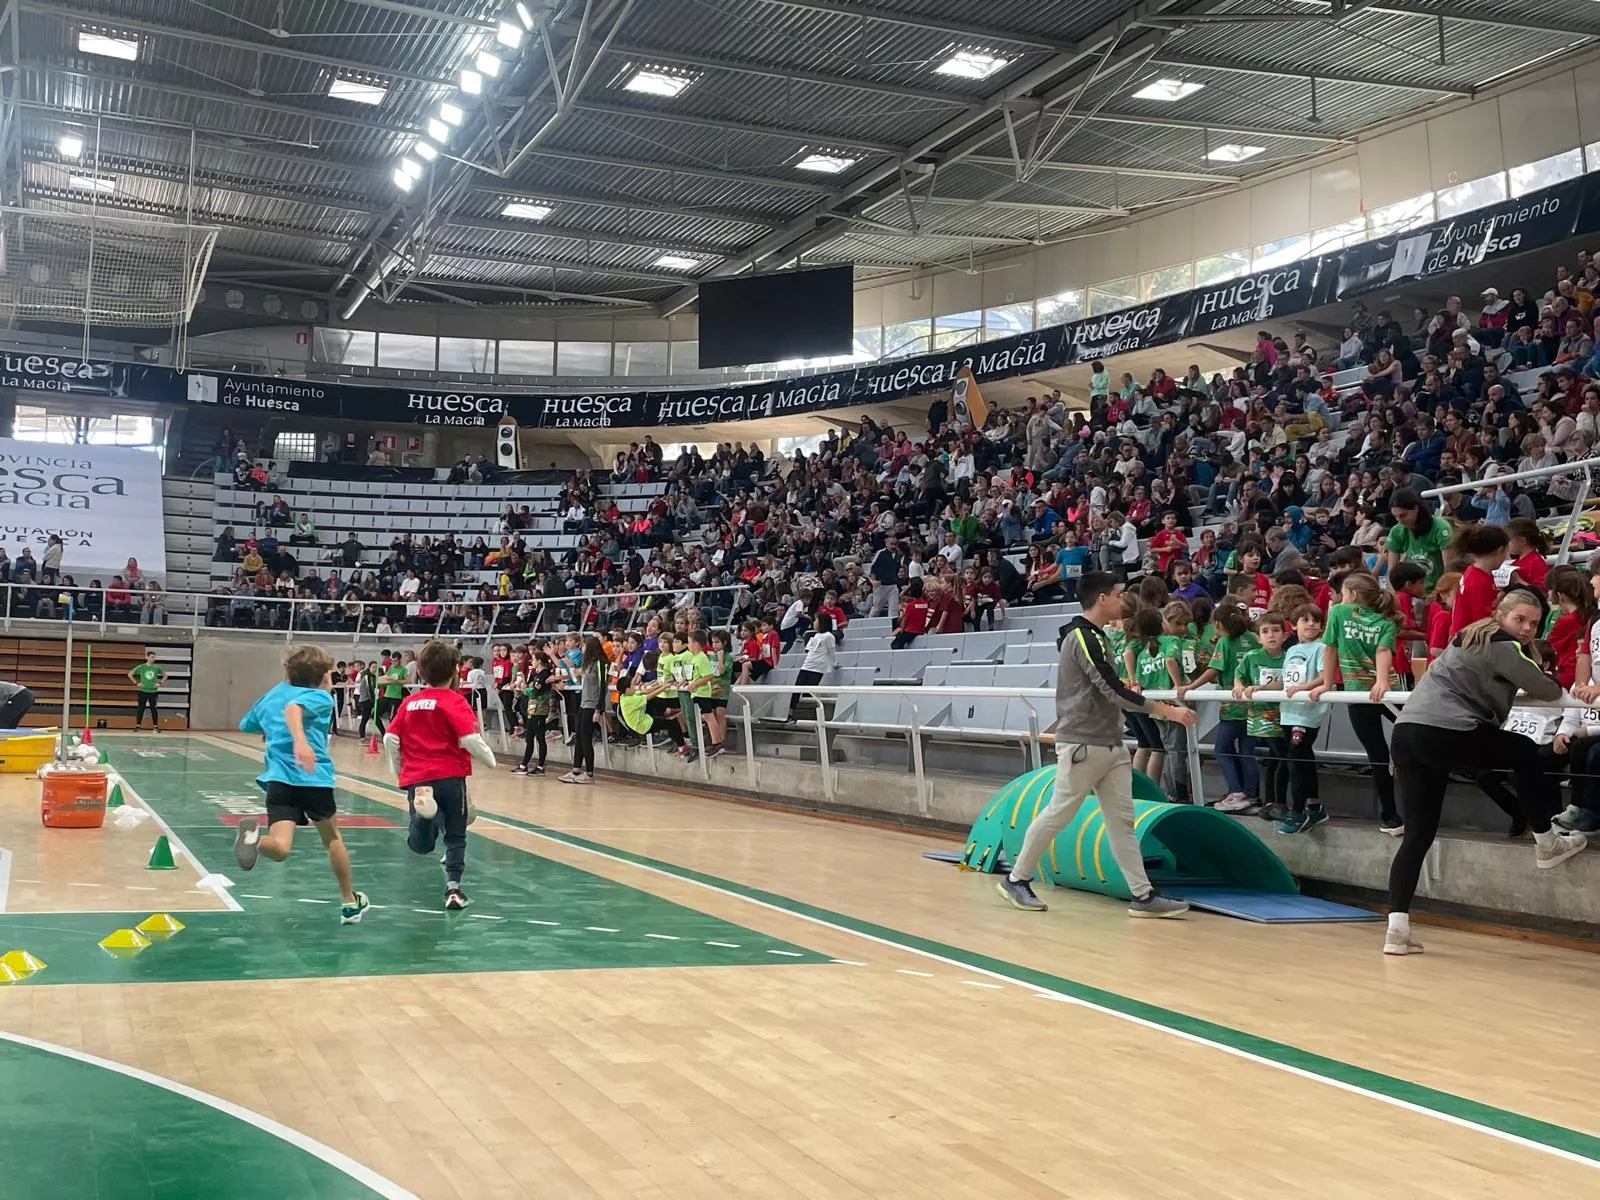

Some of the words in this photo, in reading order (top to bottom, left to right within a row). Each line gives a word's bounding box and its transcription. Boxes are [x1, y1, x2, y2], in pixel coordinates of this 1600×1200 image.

[1434, 198, 1560, 249] Ayuntamiento
[1428, 252, 1449, 272] de
[224, 377, 325, 400] Ayuntamiento
[223, 394, 241, 406] de
[245, 397, 300, 412] Huesca
[1510, 719, 1538, 734] 255
